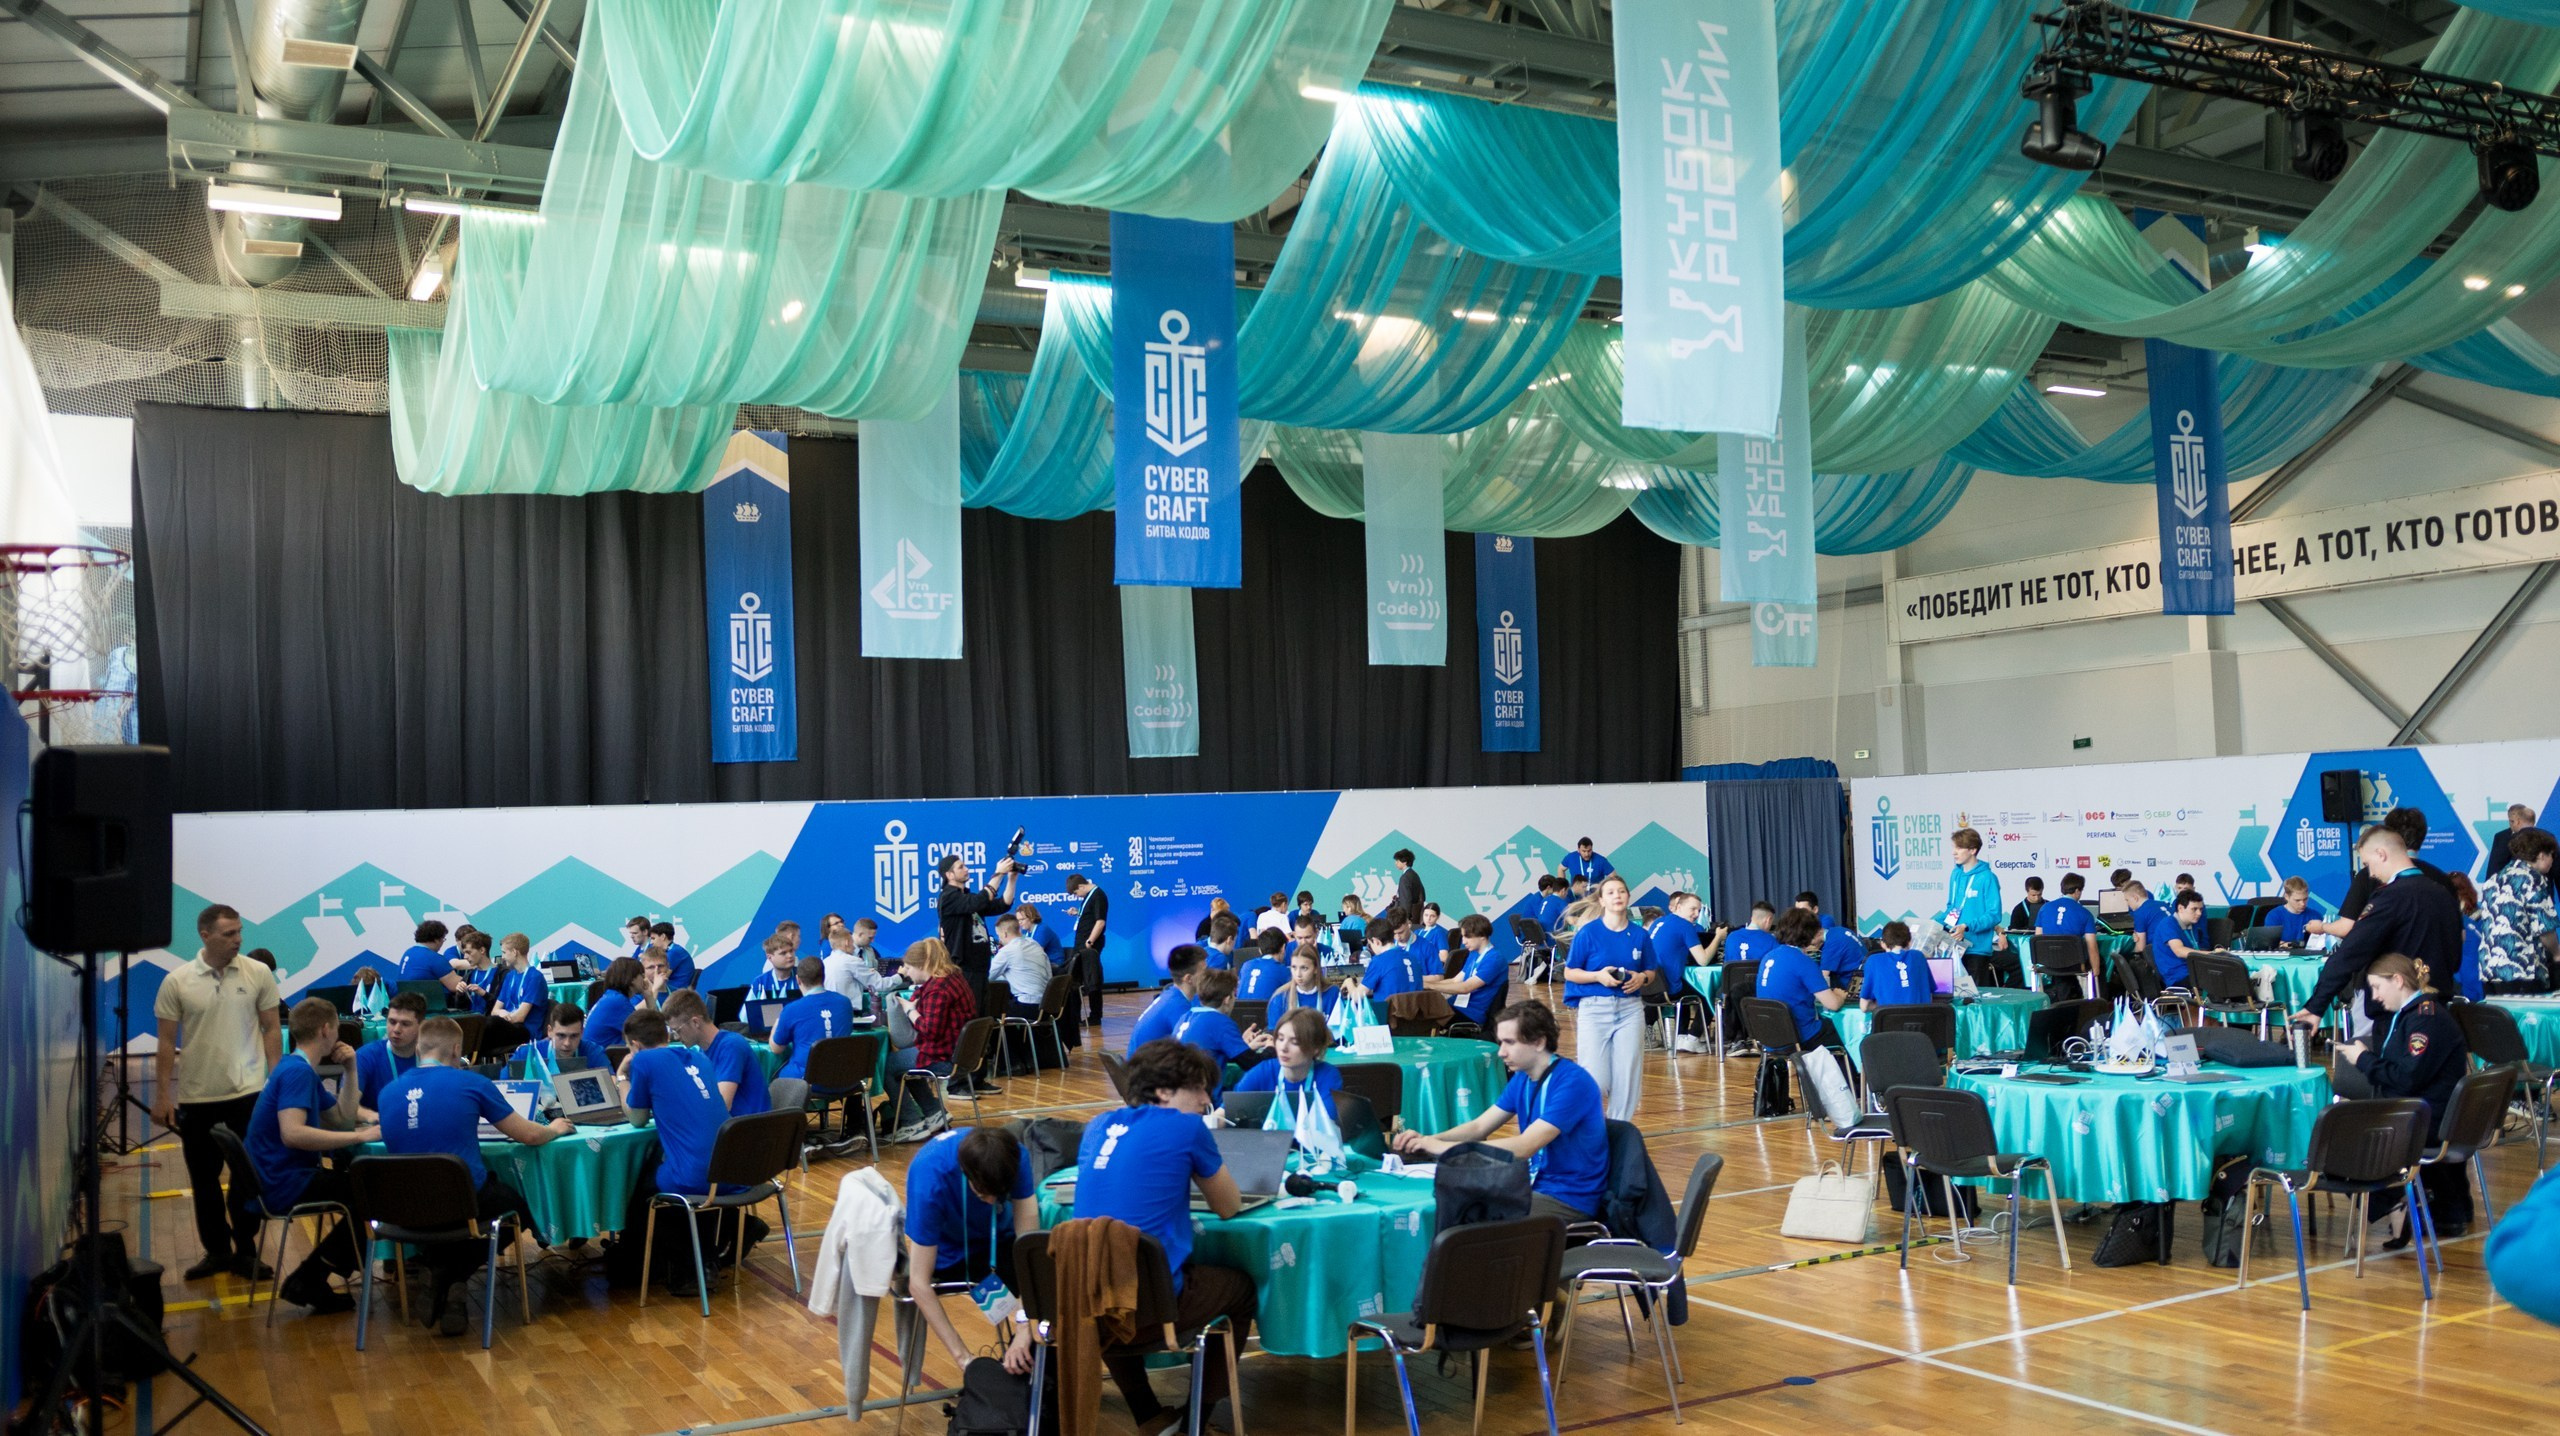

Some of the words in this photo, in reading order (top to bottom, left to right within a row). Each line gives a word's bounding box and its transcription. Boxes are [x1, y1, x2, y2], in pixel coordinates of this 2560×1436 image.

[1697, 19, 1741, 287] РОССИИ
[1660, 56, 1703, 282] КУБОК
[1144, 464, 1210, 494] CYBER
[1745, 431, 1768, 518] КУБ
[1145, 493, 1210, 523] CRAFT
[1145, 524, 1177, 538] БИТВА
[1178, 526, 1211, 540] КОДОВ
[2175, 526, 2211, 545] CYBER
[1906, 582, 2013, 621] «ПОБЕДИТ
[2020, 577, 2048, 607] НЕ
[2053, 569, 2100, 602] ТОТ,
[2106, 561, 2151, 594] КТО
[2293, 536, 2312, 568] А
[2318, 525, 2378, 562] ТОТ,
[2386, 516, 2445, 553] КТО
[2455, 499, 2560, 544] ГОТОВ
[2177, 547, 2212, 567] CRAFT
[907, 582, 930, 591] Vrn
[907, 592, 953, 610] CTF
[731, 687, 775, 704] CYBER
[1494, 690, 1524, 704] CYBER
[732, 706, 775, 722] CRAFT
[1495, 705, 1524, 719] CRAFT
[732, 724, 753, 733] БИТВА
[754, 724, 776, 733] КОДОВ
[1903, 814, 1942, 834] CYBER
[2085, 811, 2106, 821] OCS
[2316, 827, 2341, 838] CYBER
[1128, 836, 1143, 851] 20
[1904, 837, 1942, 857] CRAFT
[2317, 839, 2342, 850] CRAFT
[1129, 851, 1143, 867] 26
[1994, 859, 2036, 871] Северсталь
